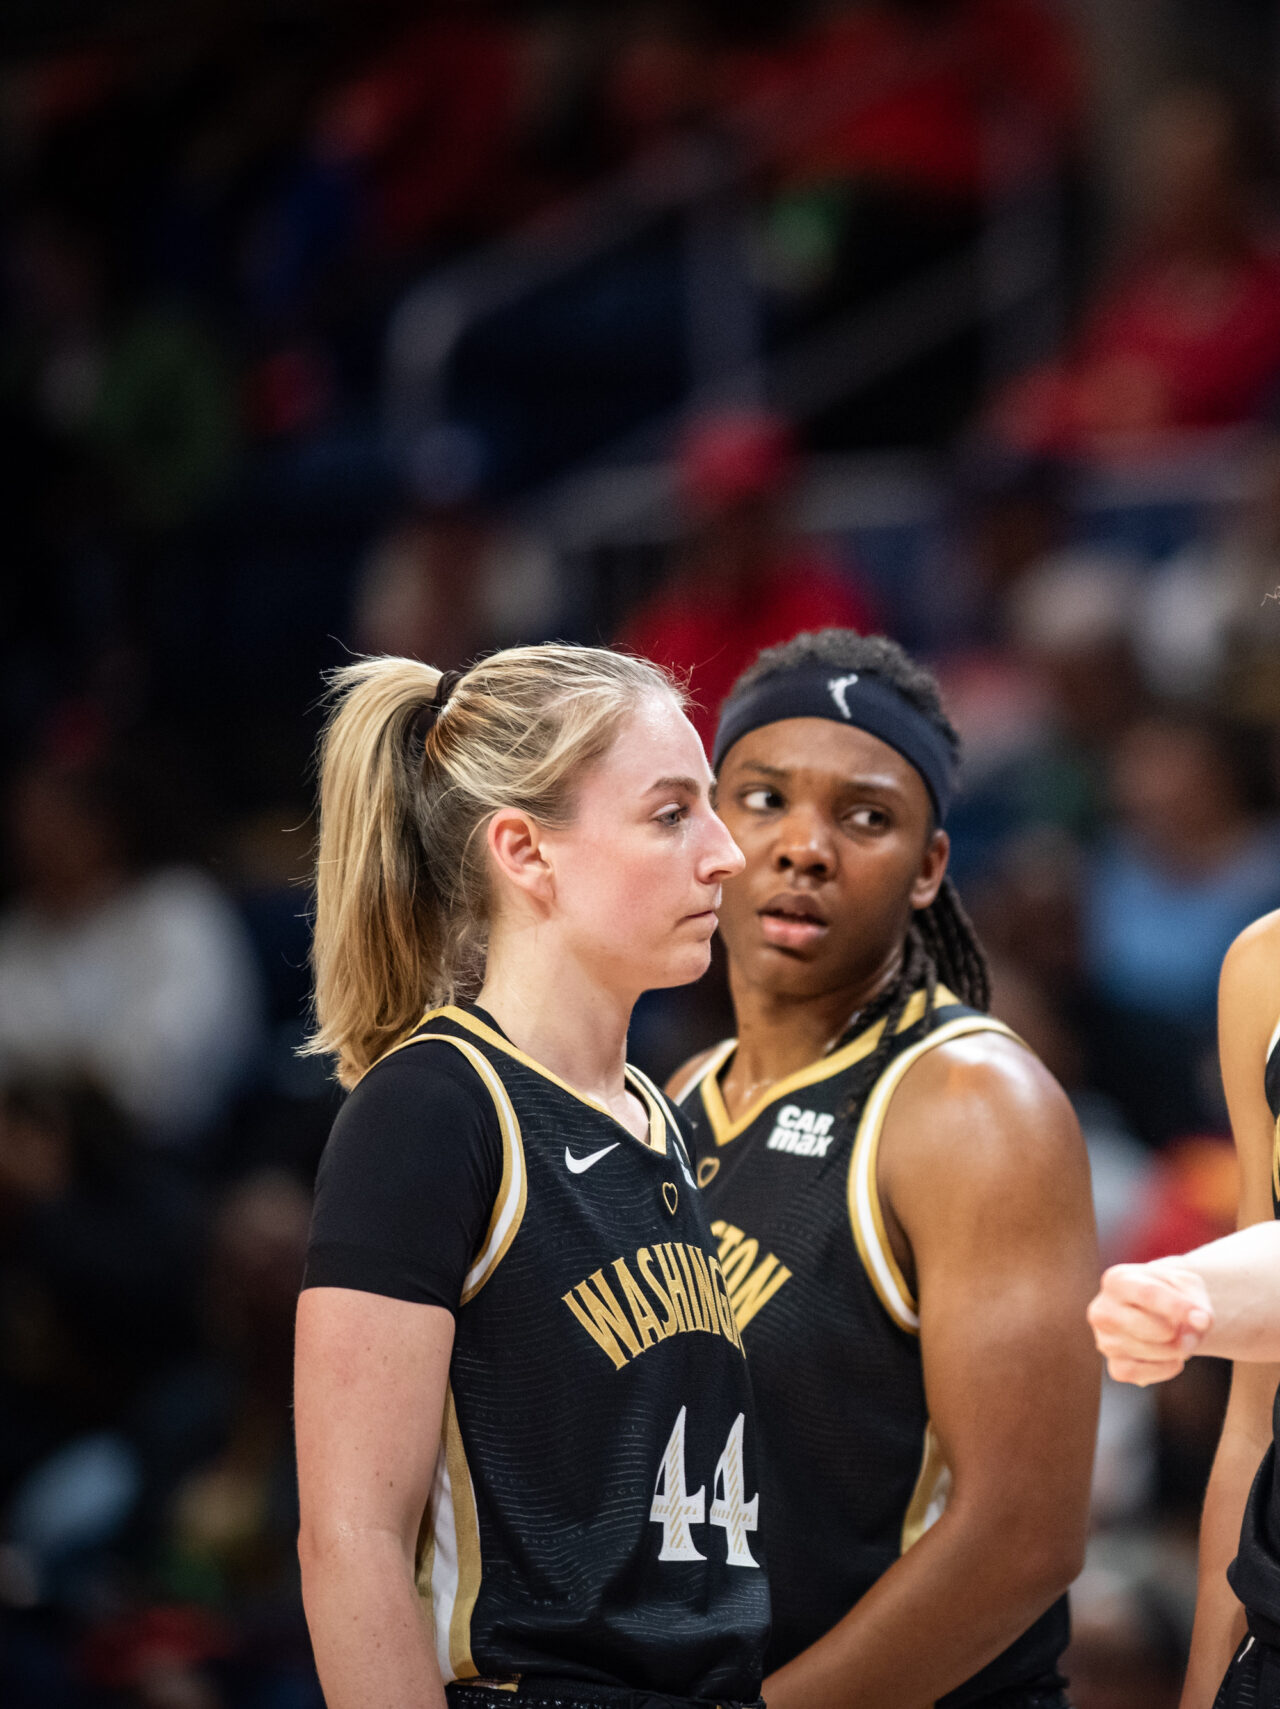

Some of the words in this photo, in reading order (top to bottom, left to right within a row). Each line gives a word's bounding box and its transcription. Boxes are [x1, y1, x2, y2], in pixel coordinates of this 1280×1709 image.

[777, 1104, 835, 1137] CAR
[561, 1241, 747, 1371] WASHING
[710, 1220, 793, 1335] TON
[649, 1404, 761, 1568] 44
